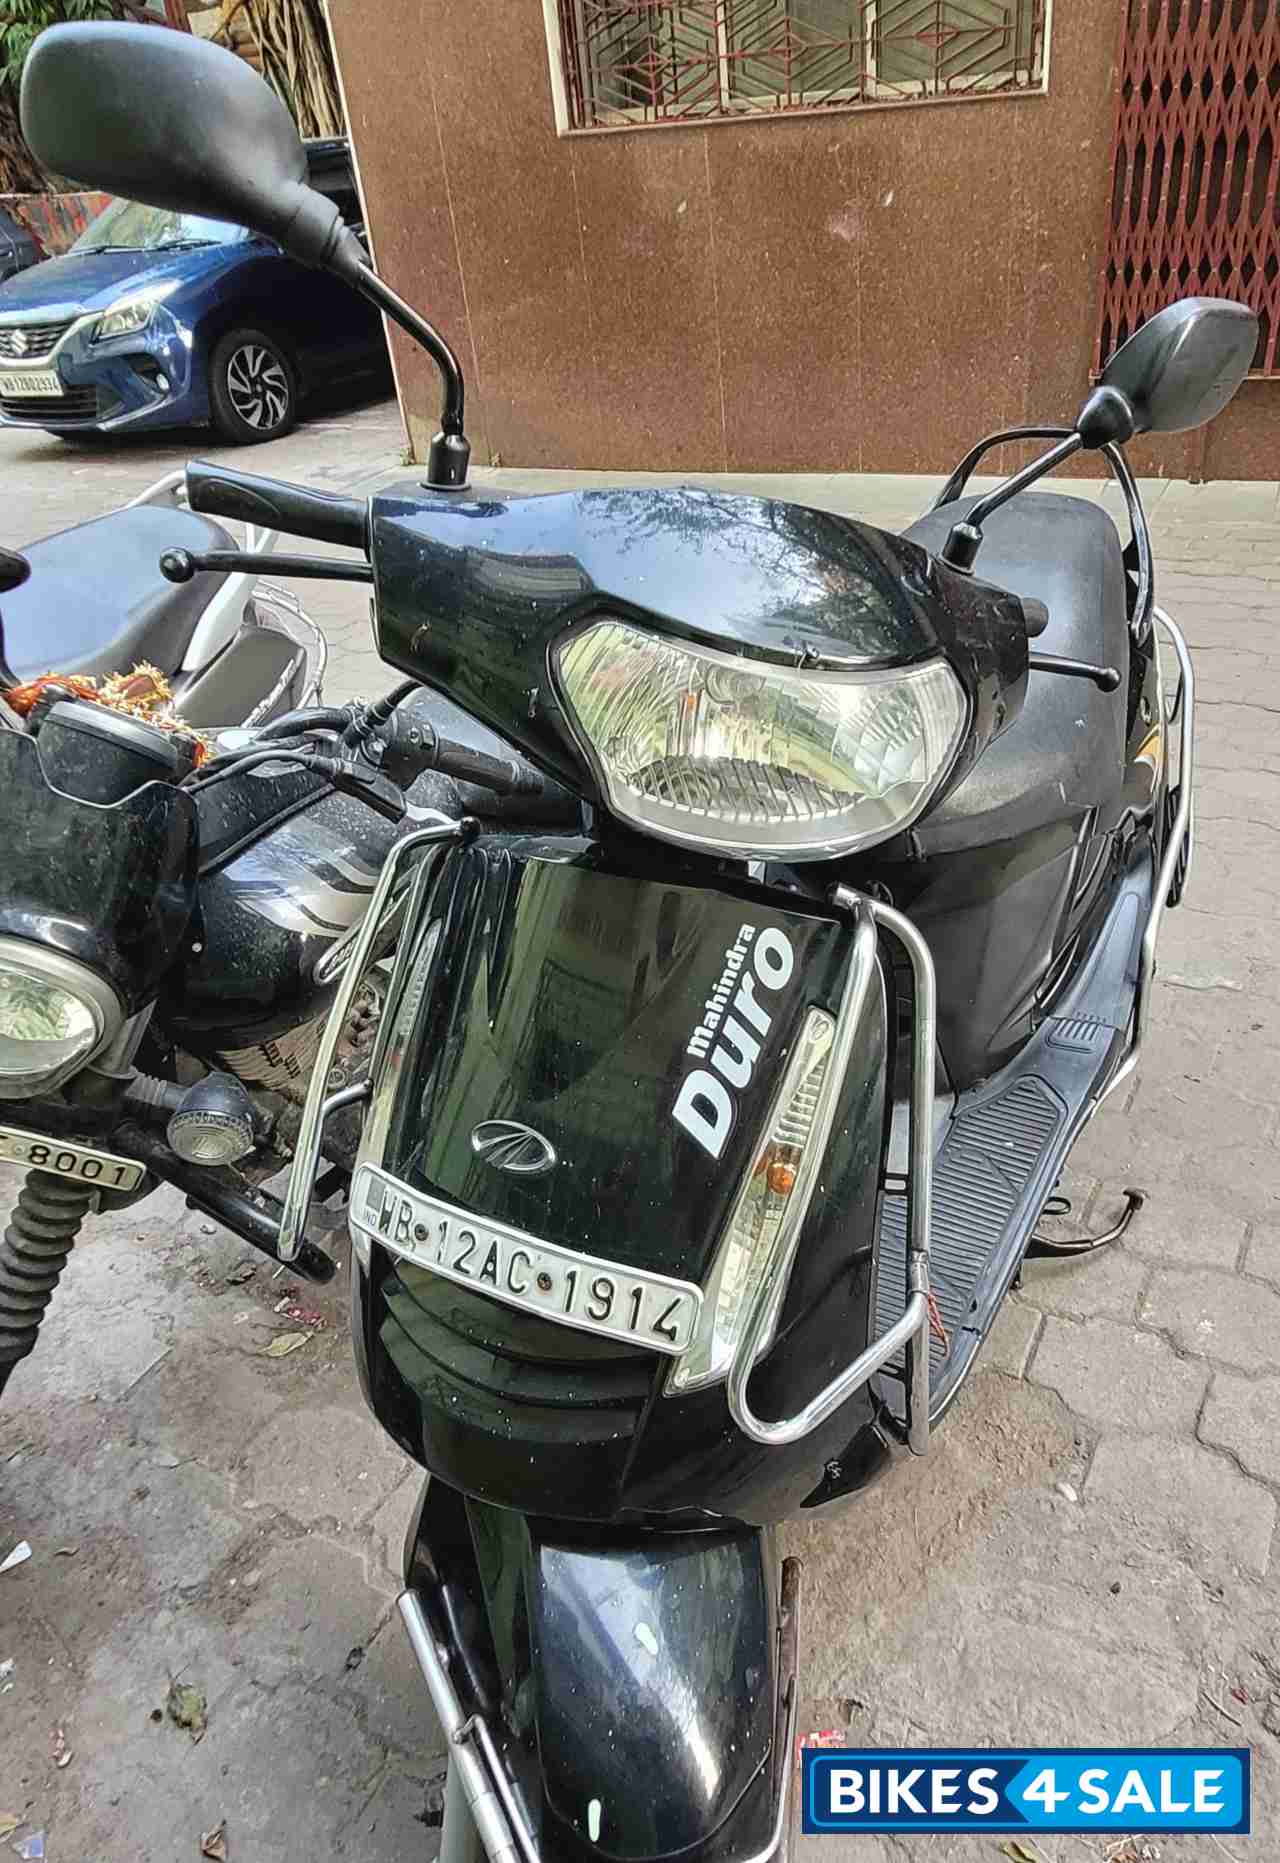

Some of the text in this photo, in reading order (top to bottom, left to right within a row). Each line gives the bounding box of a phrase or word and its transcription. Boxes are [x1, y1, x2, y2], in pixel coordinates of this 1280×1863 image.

[672, 927, 794, 1159] Duro
[686, 923, 756, 1059] mahindra
[28, 1143, 127, 1185] 8001
